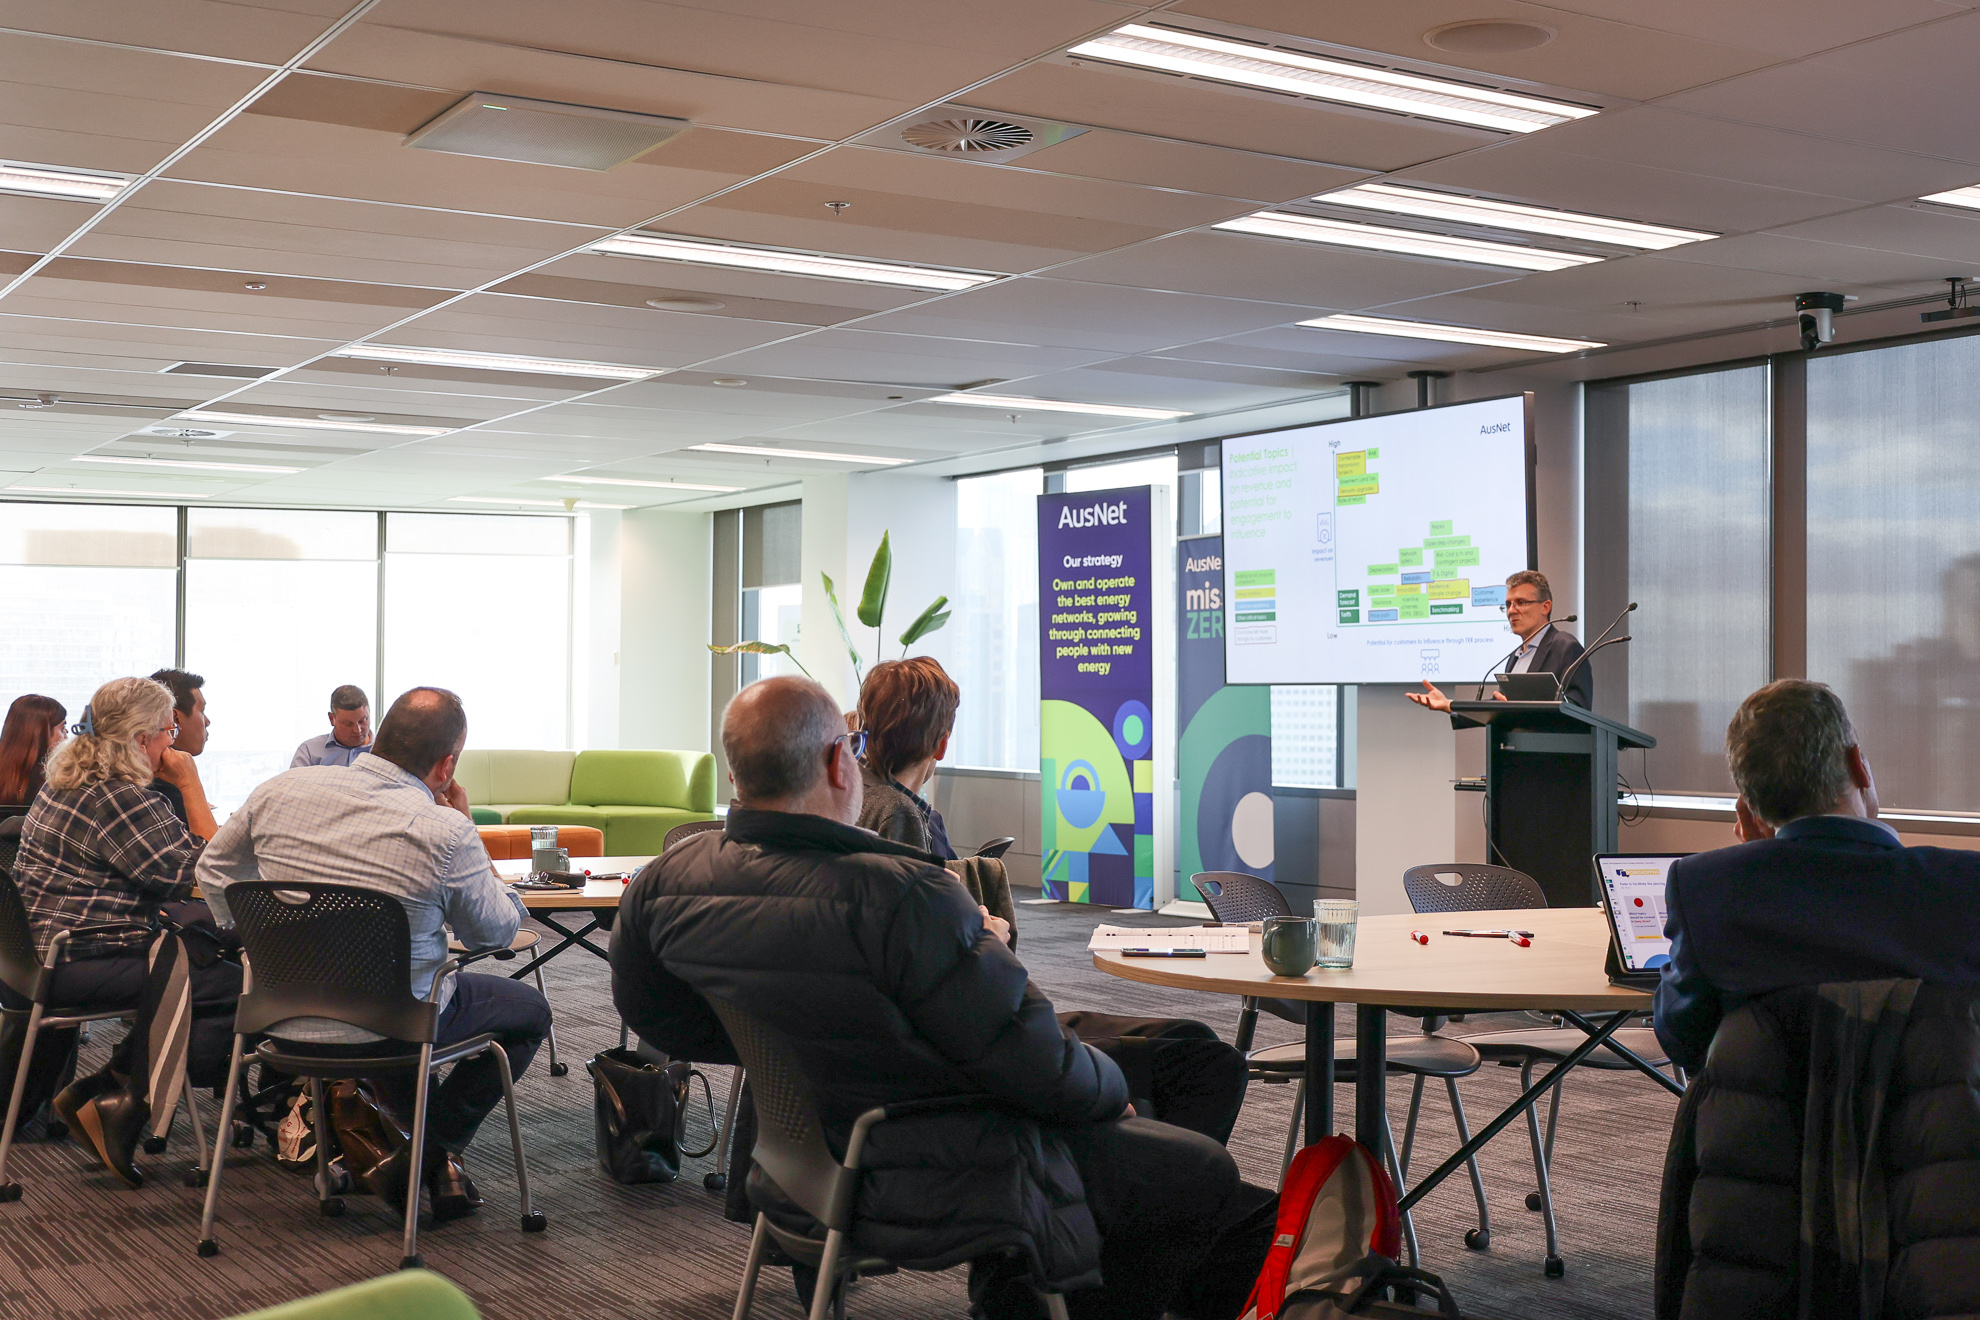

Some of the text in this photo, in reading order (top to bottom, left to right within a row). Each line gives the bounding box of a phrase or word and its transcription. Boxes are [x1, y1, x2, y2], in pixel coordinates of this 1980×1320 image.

[1480, 422, 1511, 435] AusNet
[1328, 439, 1341, 448] High
[1229, 447, 1289, 463] Potential Topics
[1229, 461, 1298, 479] Indicative impact
[1229, 478, 1292, 495] on revenue and
[1229, 496, 1264, 511] potential
[1058, 500, 1128, 529] AusNet
[1230, 511, 1282, 526] engagement
[1063, 554, 1123, 568] Our strategy
[1185, 555, 1222, 573] AusNe
[1052, 575, 1136, 592] Own and operate
[1057, 594, 1131, 608] the best energy
[1186, 580, 1223, 611] mis
[1051, 608, 1137, 625] networks, growing
[1186, 610, 1223, 639] ZER
[1048, 625, 1141, 642] through connecting
[1326, 632, 1338, 640] Low
[1445, 637, 1464, 645] through
[1474, 637, 1494, 645] process
[1056, 643, 1133, 659] people with new
[1077, 662, 1111, 675] energy
